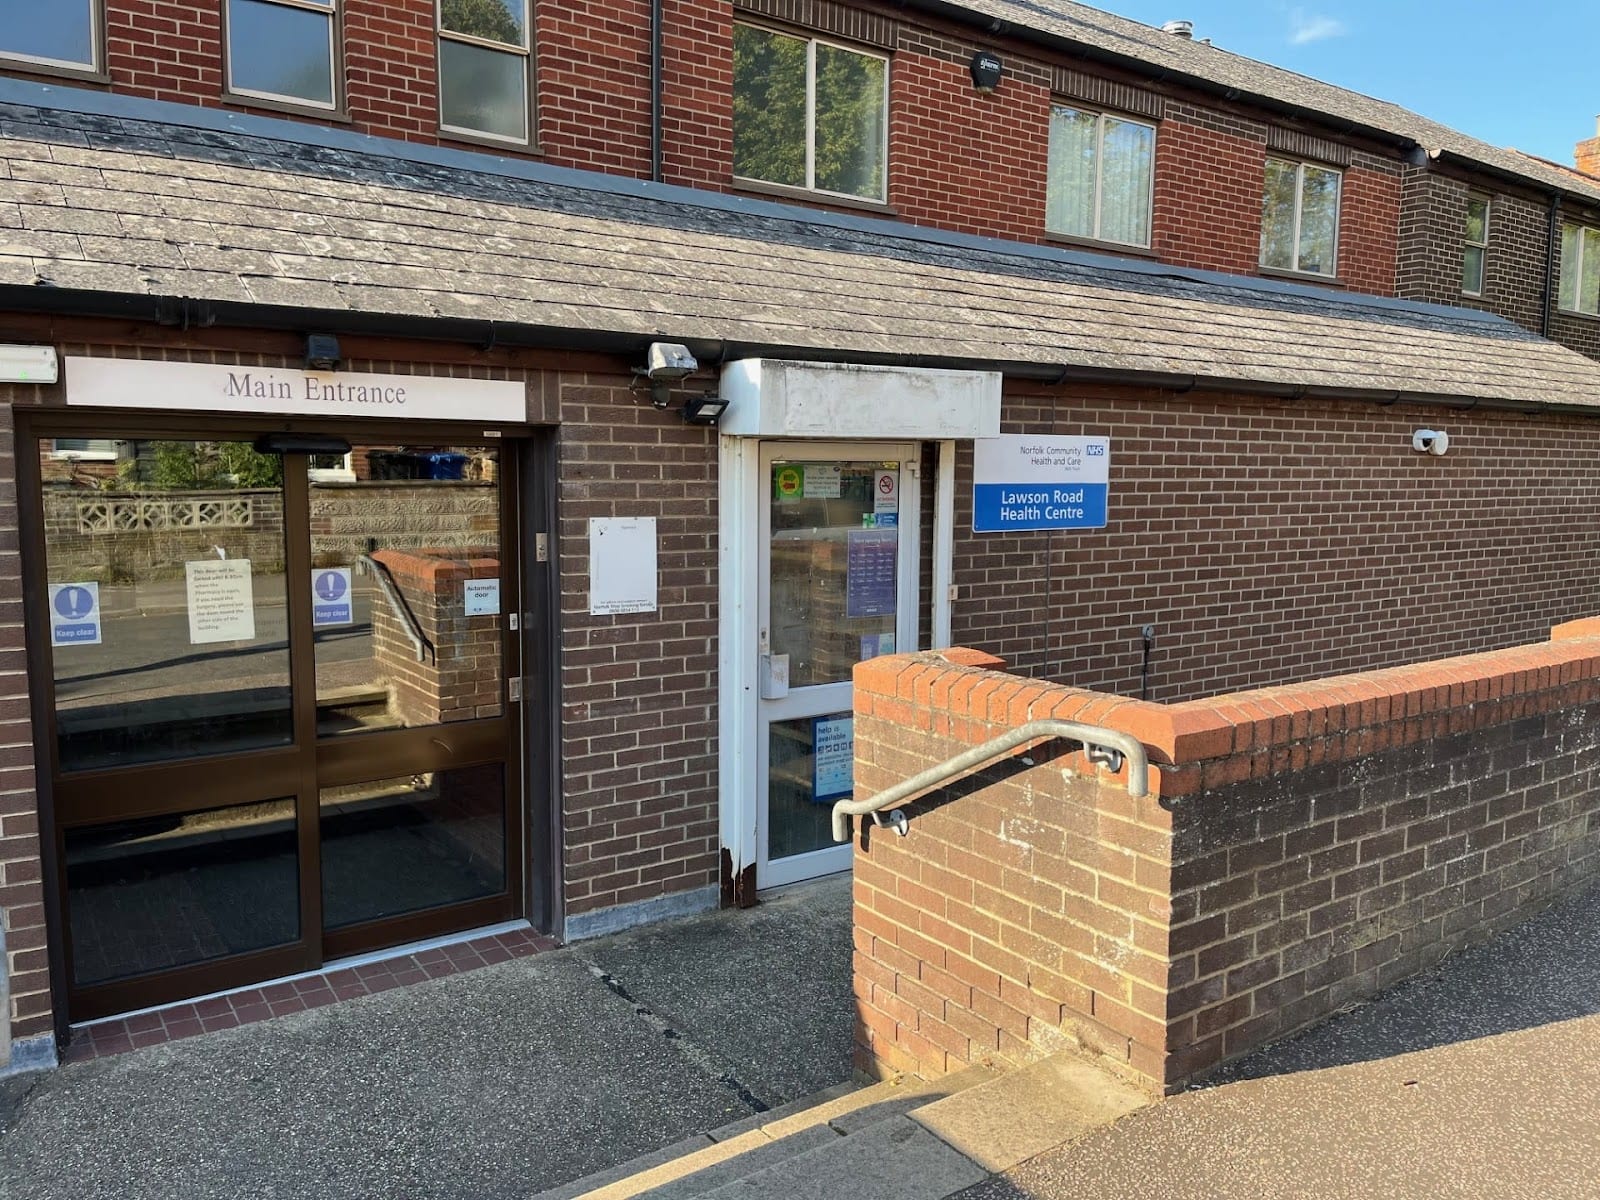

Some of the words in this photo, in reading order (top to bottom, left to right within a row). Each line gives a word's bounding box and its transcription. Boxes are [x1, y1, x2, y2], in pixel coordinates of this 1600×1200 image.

[228, 372, 292, 399] Main
[304, 377, 406, 404] Entrance
[1020, 446, 1043, 454] Norfolk
[1046, 446, 1081, 456] Community
[1087, 445, 1103, 455] NHS
[1031, 457, 1052, 466] Health
[1053, 457, 1065, 465] and
[1067, 457, 1081, 465] Care
[1002, 490, 1048, 504] Lawson
[1053, 489, 1084, 503] Road
[1001, 505, 1040, 521] Health
[1045, 506, 1084, 520] Centre
[56, 630, 75, 638] Keep
[76, 628, 94, 636] clear
[818, 726, 831, 735] help
[818, 733, 846, 743] available
